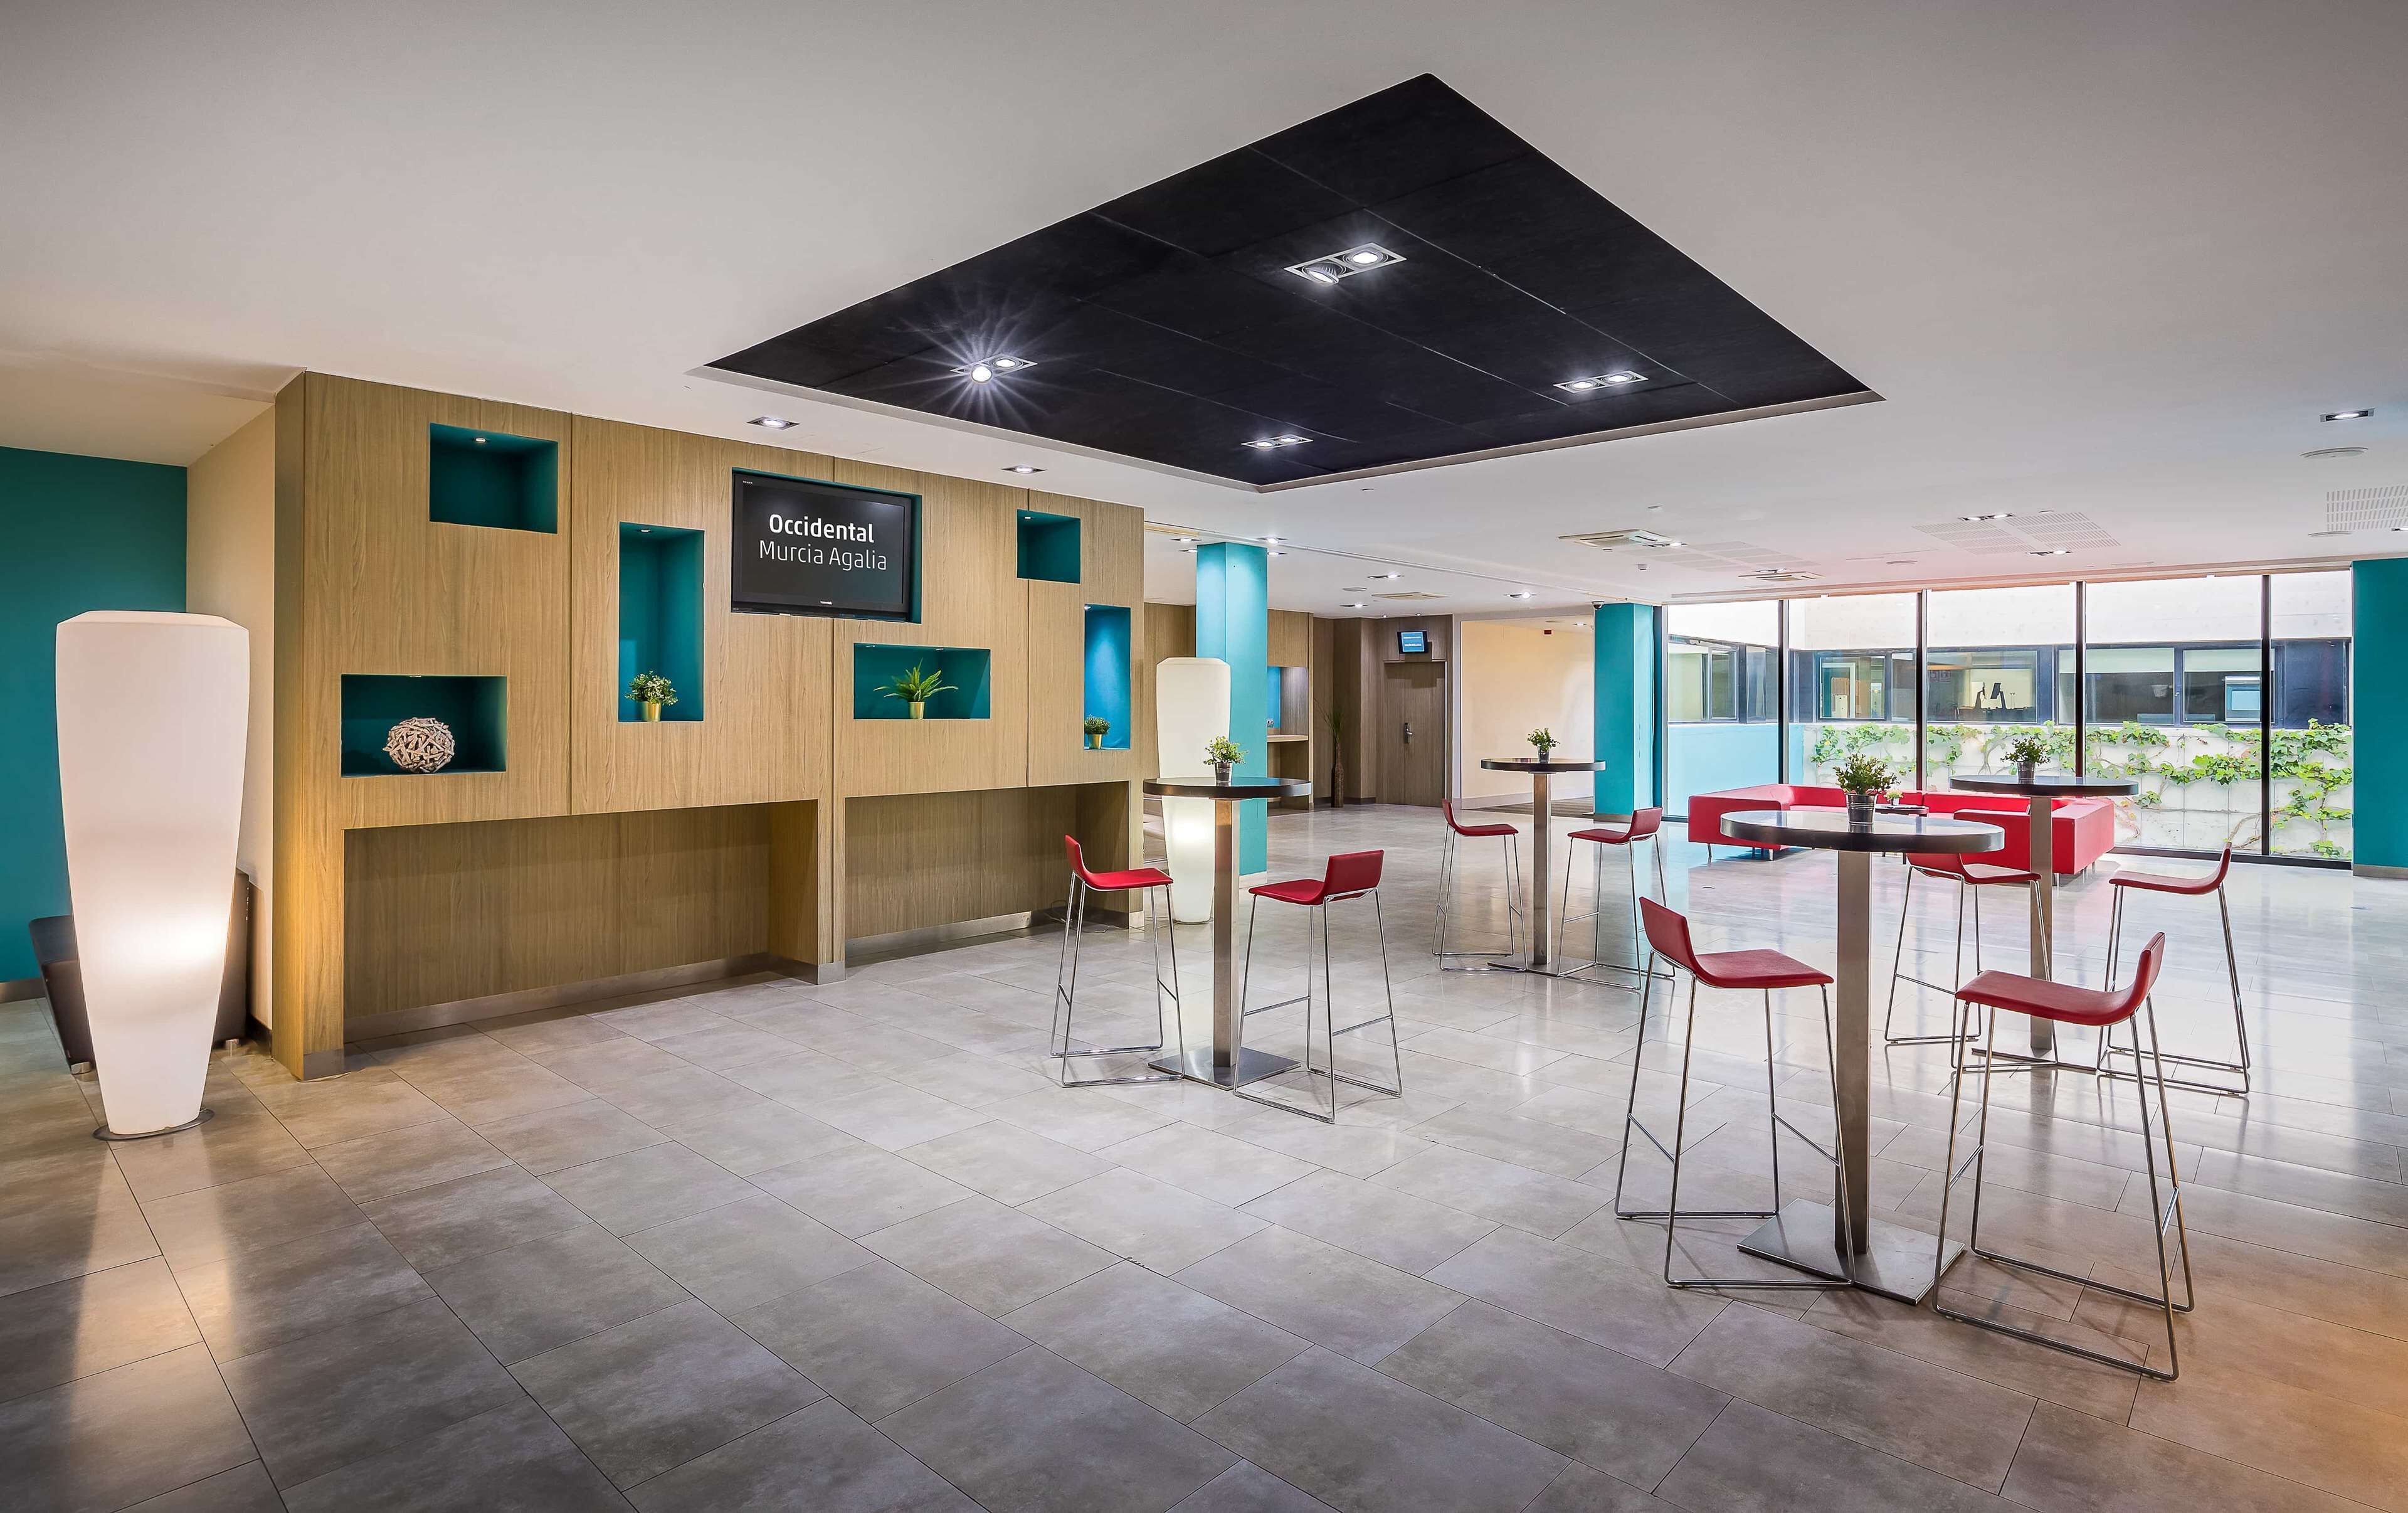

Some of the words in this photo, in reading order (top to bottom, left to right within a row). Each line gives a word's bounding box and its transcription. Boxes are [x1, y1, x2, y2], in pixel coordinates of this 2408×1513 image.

[769, 514, 874, 543] Occidental
[759, 539, 823, 565] Murcia
[828, 547, 887, 571] Agalia
